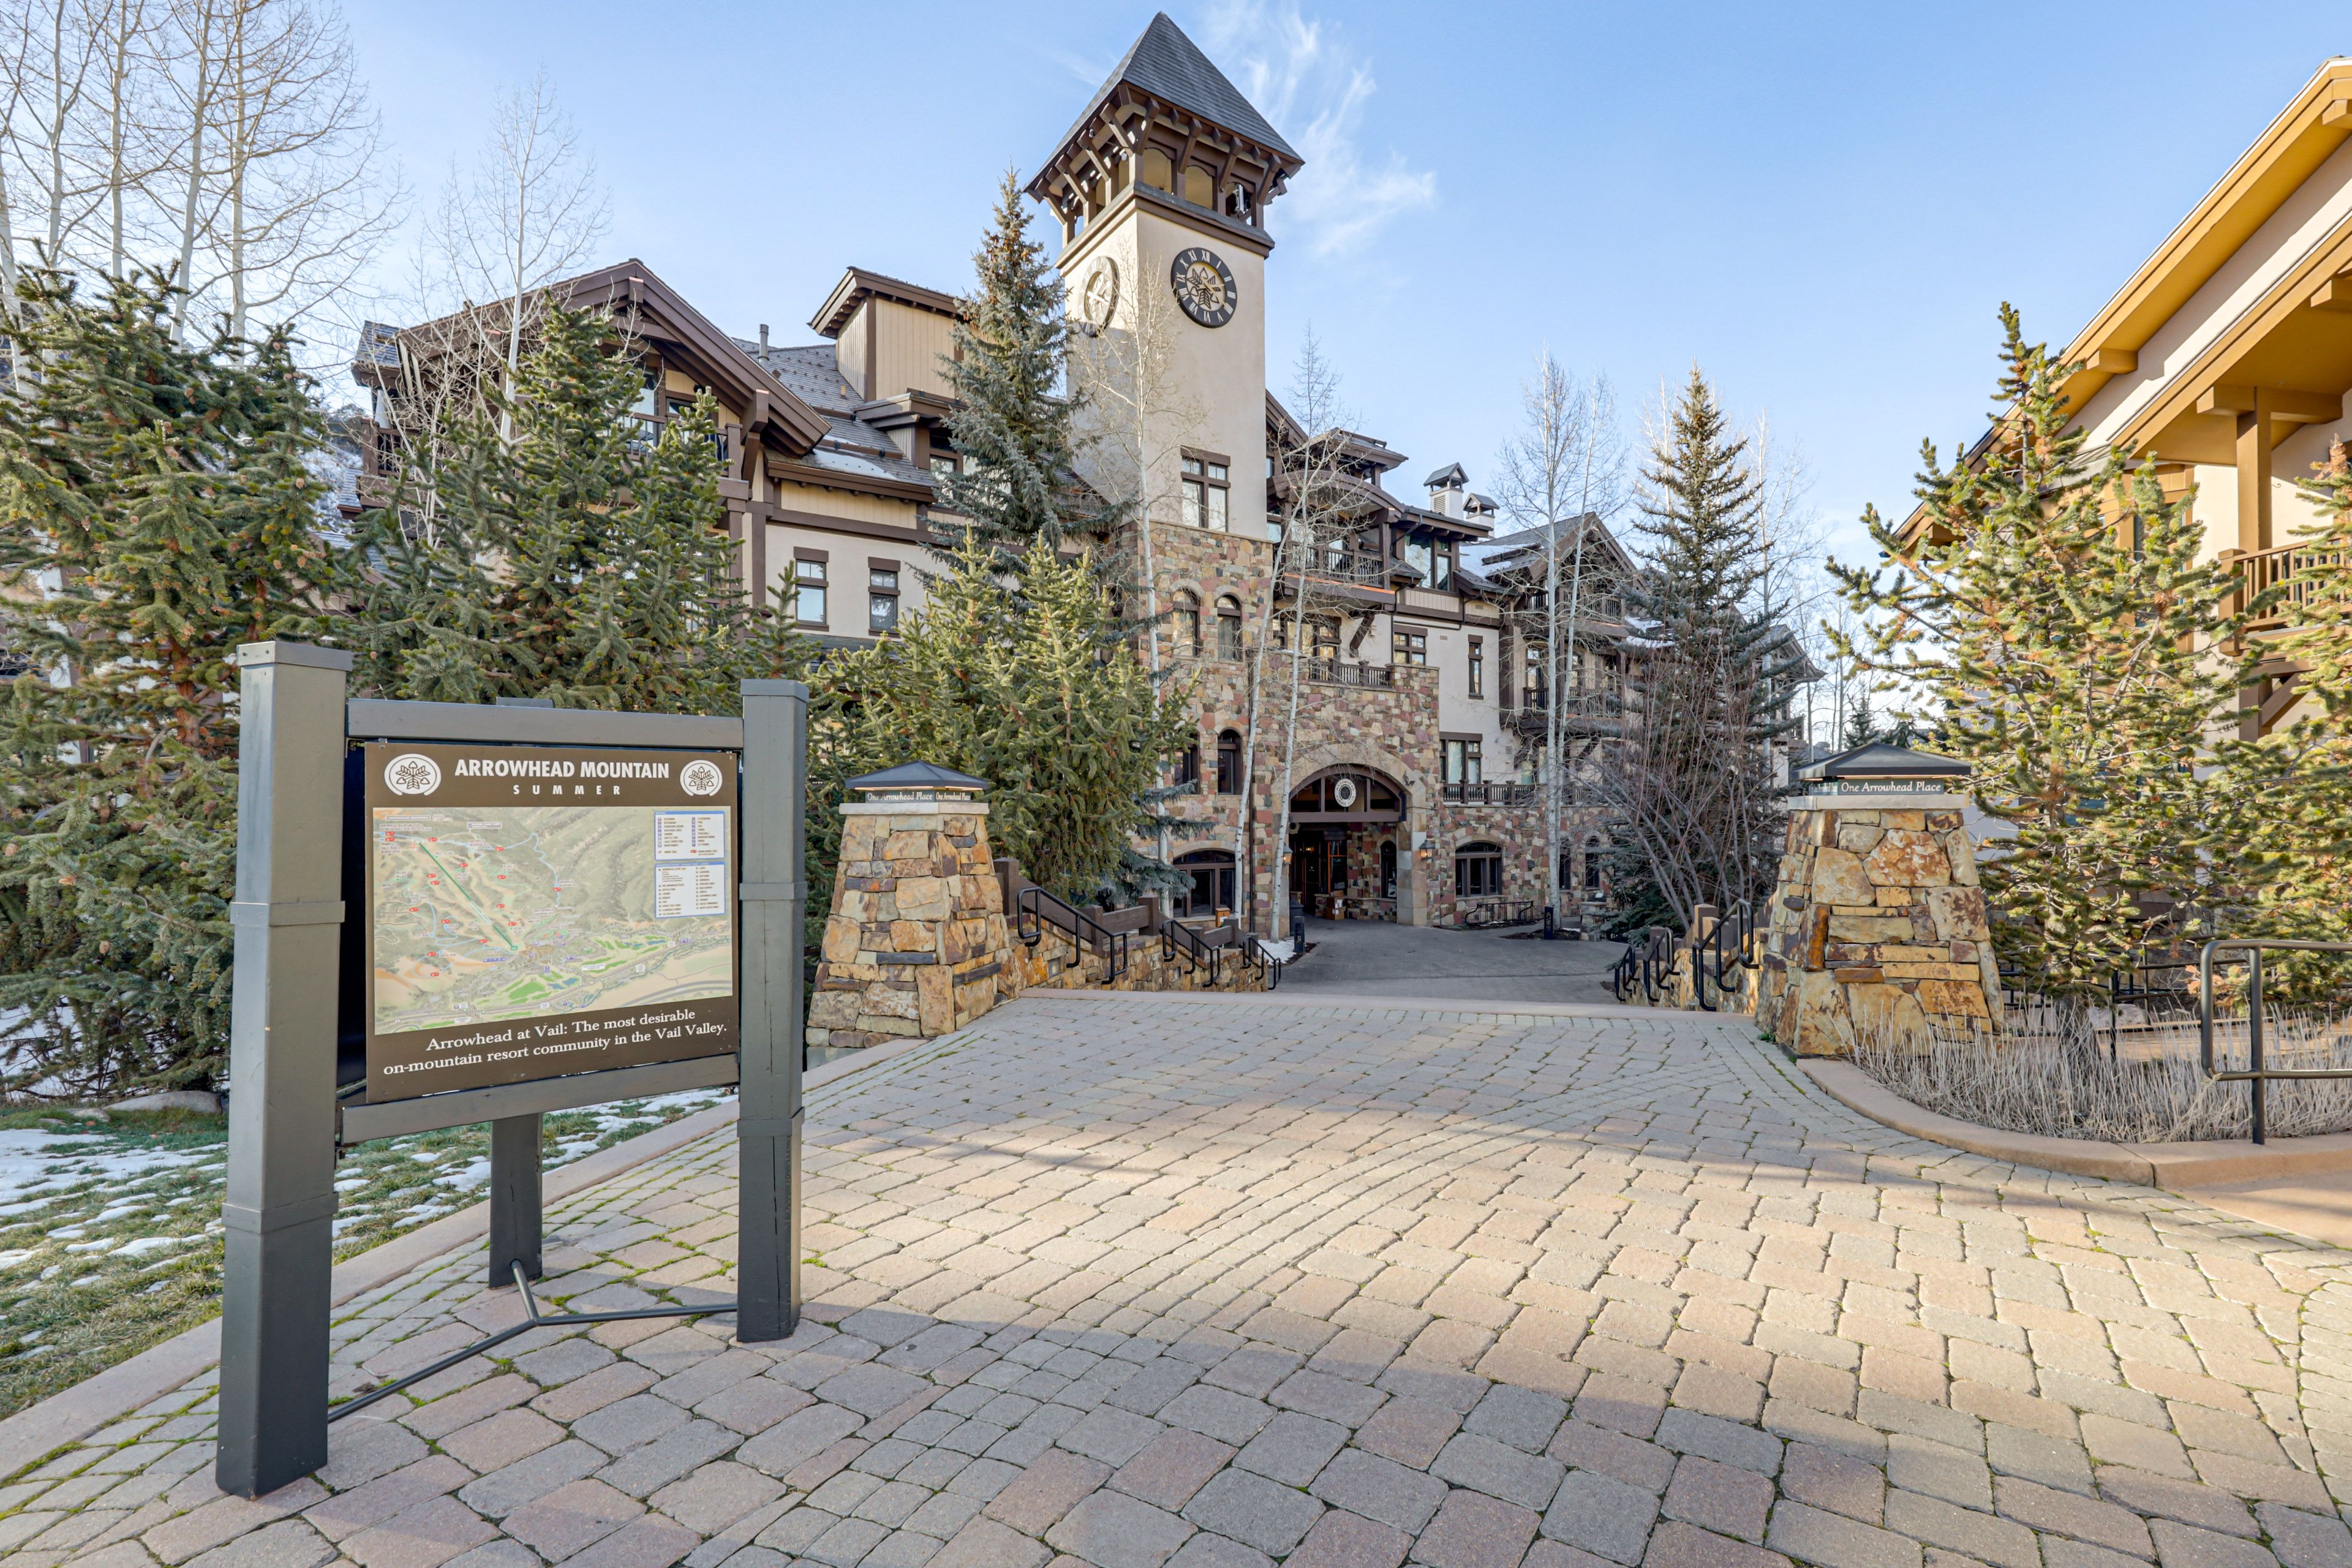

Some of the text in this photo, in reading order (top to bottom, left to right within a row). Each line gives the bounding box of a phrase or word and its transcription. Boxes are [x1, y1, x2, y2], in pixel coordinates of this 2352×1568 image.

[1188, 249, 1197, 262] XI
[1202, 249, 1210, 263] XII
[1180, 258, 1188, 270] X
[1176, 272, 1186, 283] IX
[1179, 287, 1189, 301] VIII
[1189, 303, 1198, 315] VII
[1204, 311, 1211, 323] VI
[1217, 312, 1223, 322] V
[454, 759, 669, 778] ARROWHEAD MOUNTAIN
[513, 785, 620, 795] SUMMER
[1841, 782, 1860, 791] One
[1861, 781, 1913, 792] Arrowhead
[1915, 781, 1941, 791] Place
[867, 791, 933, 801] One Arrowhead Place
[426, 1009, 696, 1051] Arrowhead at Vail: The most desirable
[383, 1022, 727, 1075] on-mountain resort community in the Vail Valley.
